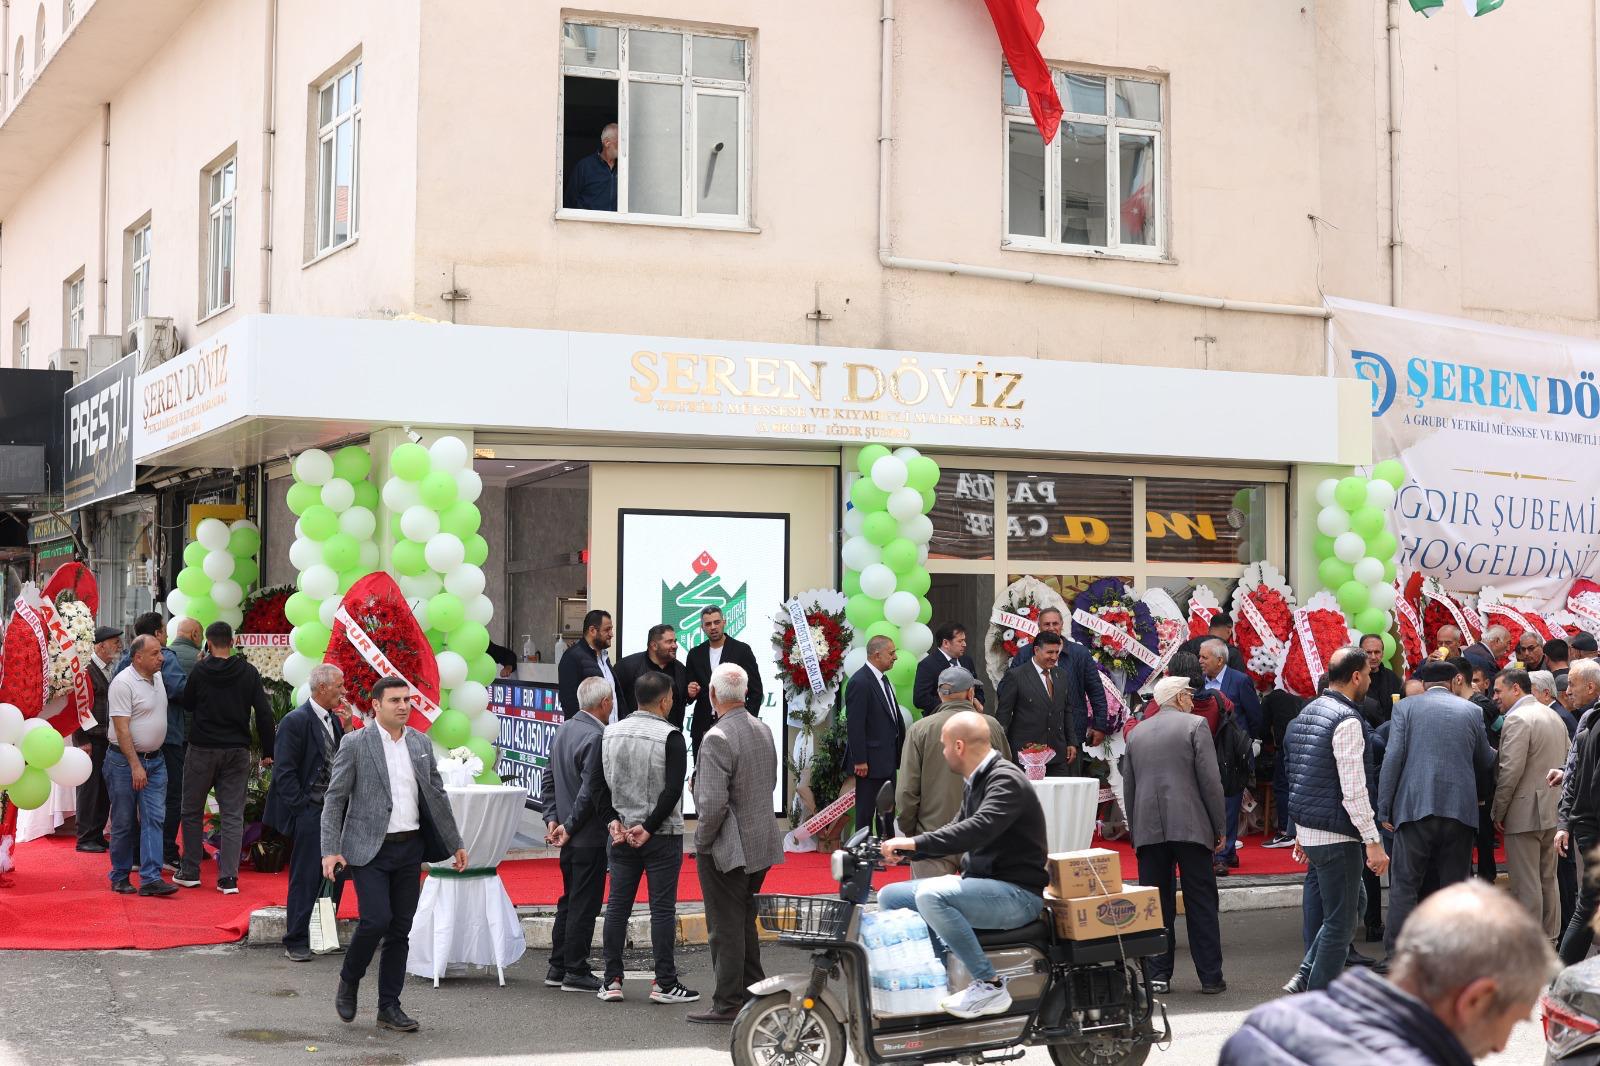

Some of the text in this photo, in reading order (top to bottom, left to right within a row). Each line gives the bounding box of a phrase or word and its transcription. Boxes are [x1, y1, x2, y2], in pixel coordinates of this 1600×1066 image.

[630, 350, 1025, 410] ŞEREN DÖVİZ
[1407, 356, 1600, 419] ŞEREN DÖ
[809, 408, 830, 419] VE
[1002, 417, 1025, 430] A.Ş.
[1403, 414, 1597, 446] A GRUBU YETKİLİ MÜESSESE VE KIYMETLİ
[1491, 495, 1600, 536] ŞUBEMİ
[495, 687, 504, 703] USD
[523, 689, 534, 707] EUR
[515, 720, 542, 753] 43.050
